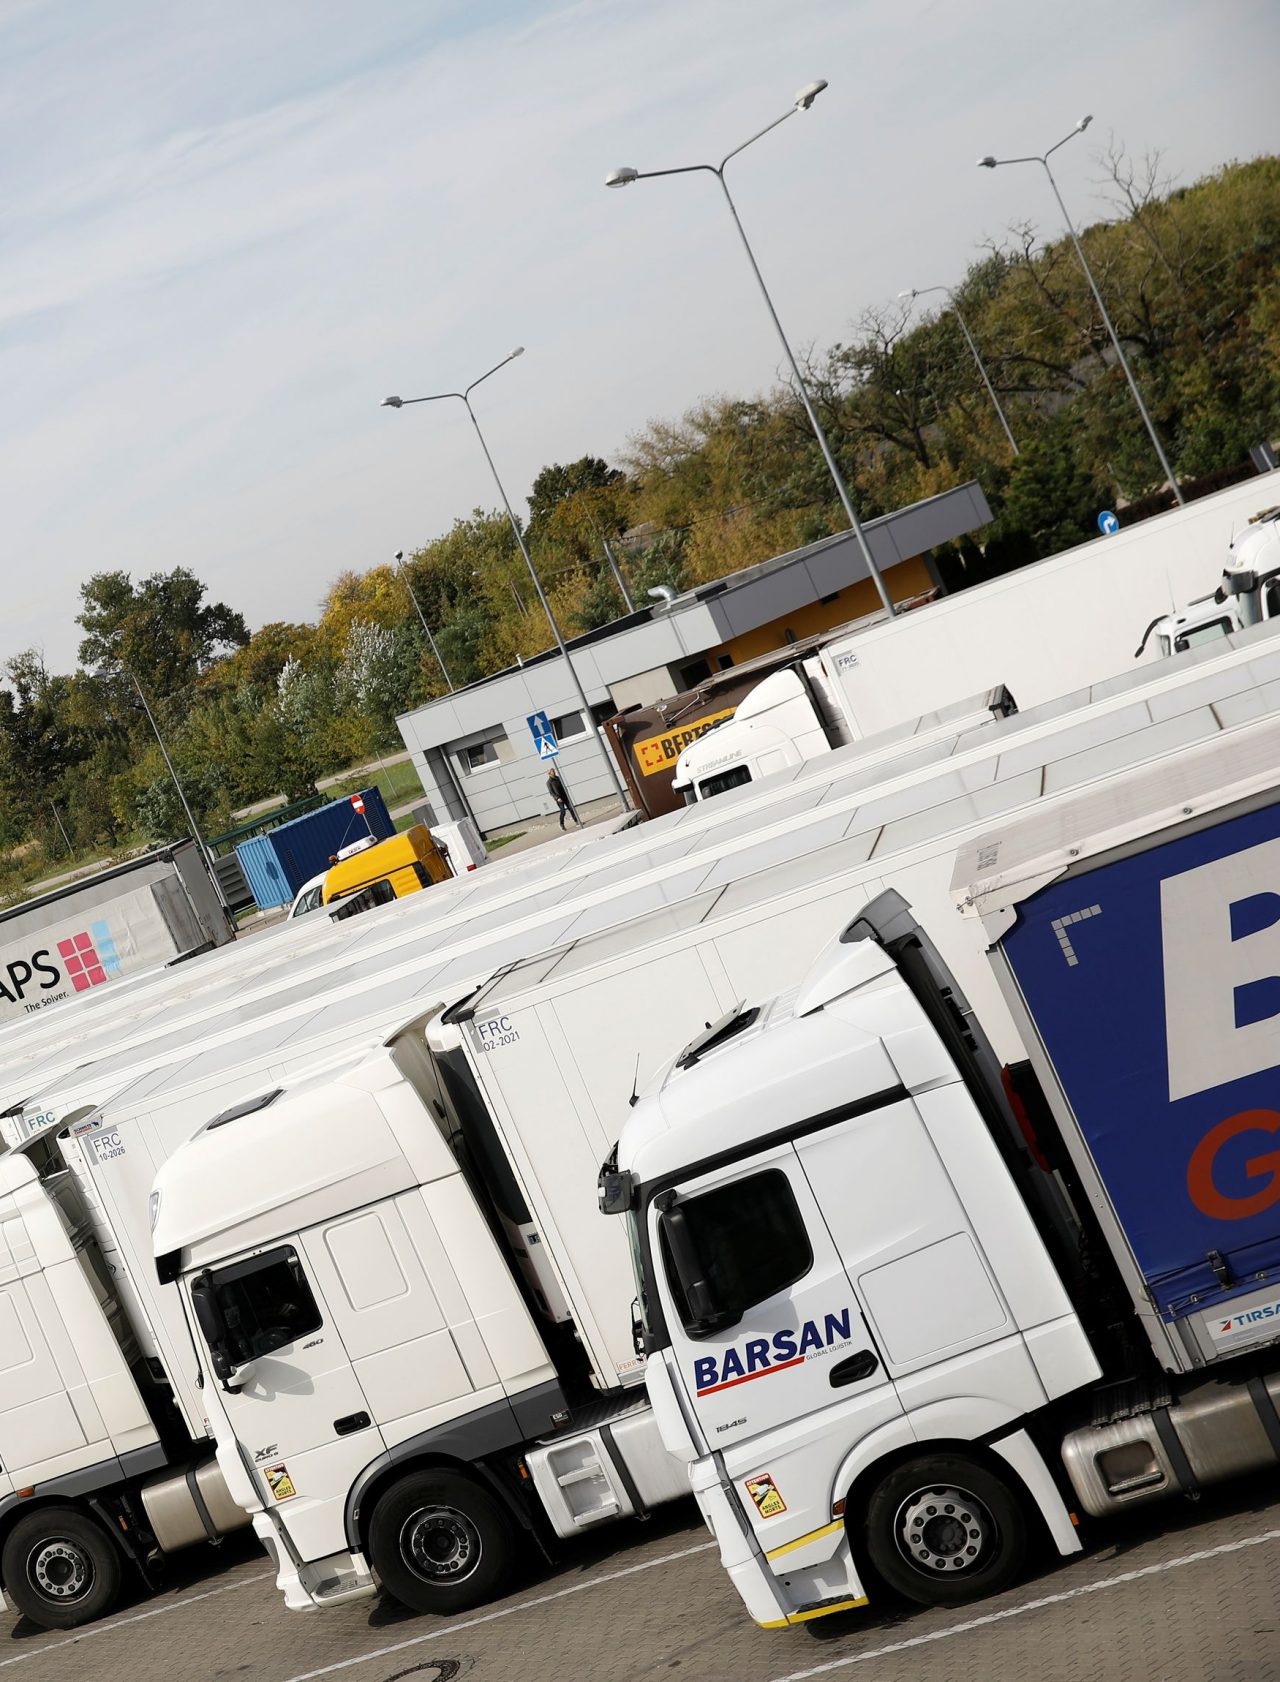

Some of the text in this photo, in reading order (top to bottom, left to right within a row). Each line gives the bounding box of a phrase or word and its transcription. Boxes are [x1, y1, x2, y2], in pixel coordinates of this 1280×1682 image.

[838, 655, 857, 667] FRC
[661, 717, 729, 760] BERT
[24, 991, 70, 1013] The Solver.
[478, 1016, 513, 1040] FRC
[483, 1031, 521, 1052] 02-2021
[28, 1112, 56, 1130] FRC
[93, 1133, 122, 1152] FRC
[100, 1146, 126, 1161] 10-2026
[694, 1308, 852, 1390] BARSAN
[806, 1349, 829, 1361] GLOBAL
[716, 1417, 747, 1433] 1845
[255, 1443, 278, 1459] XF
[762, 1500, 780, 1510] ANGLES
[764, 1505, 782, 1514] MORTS
